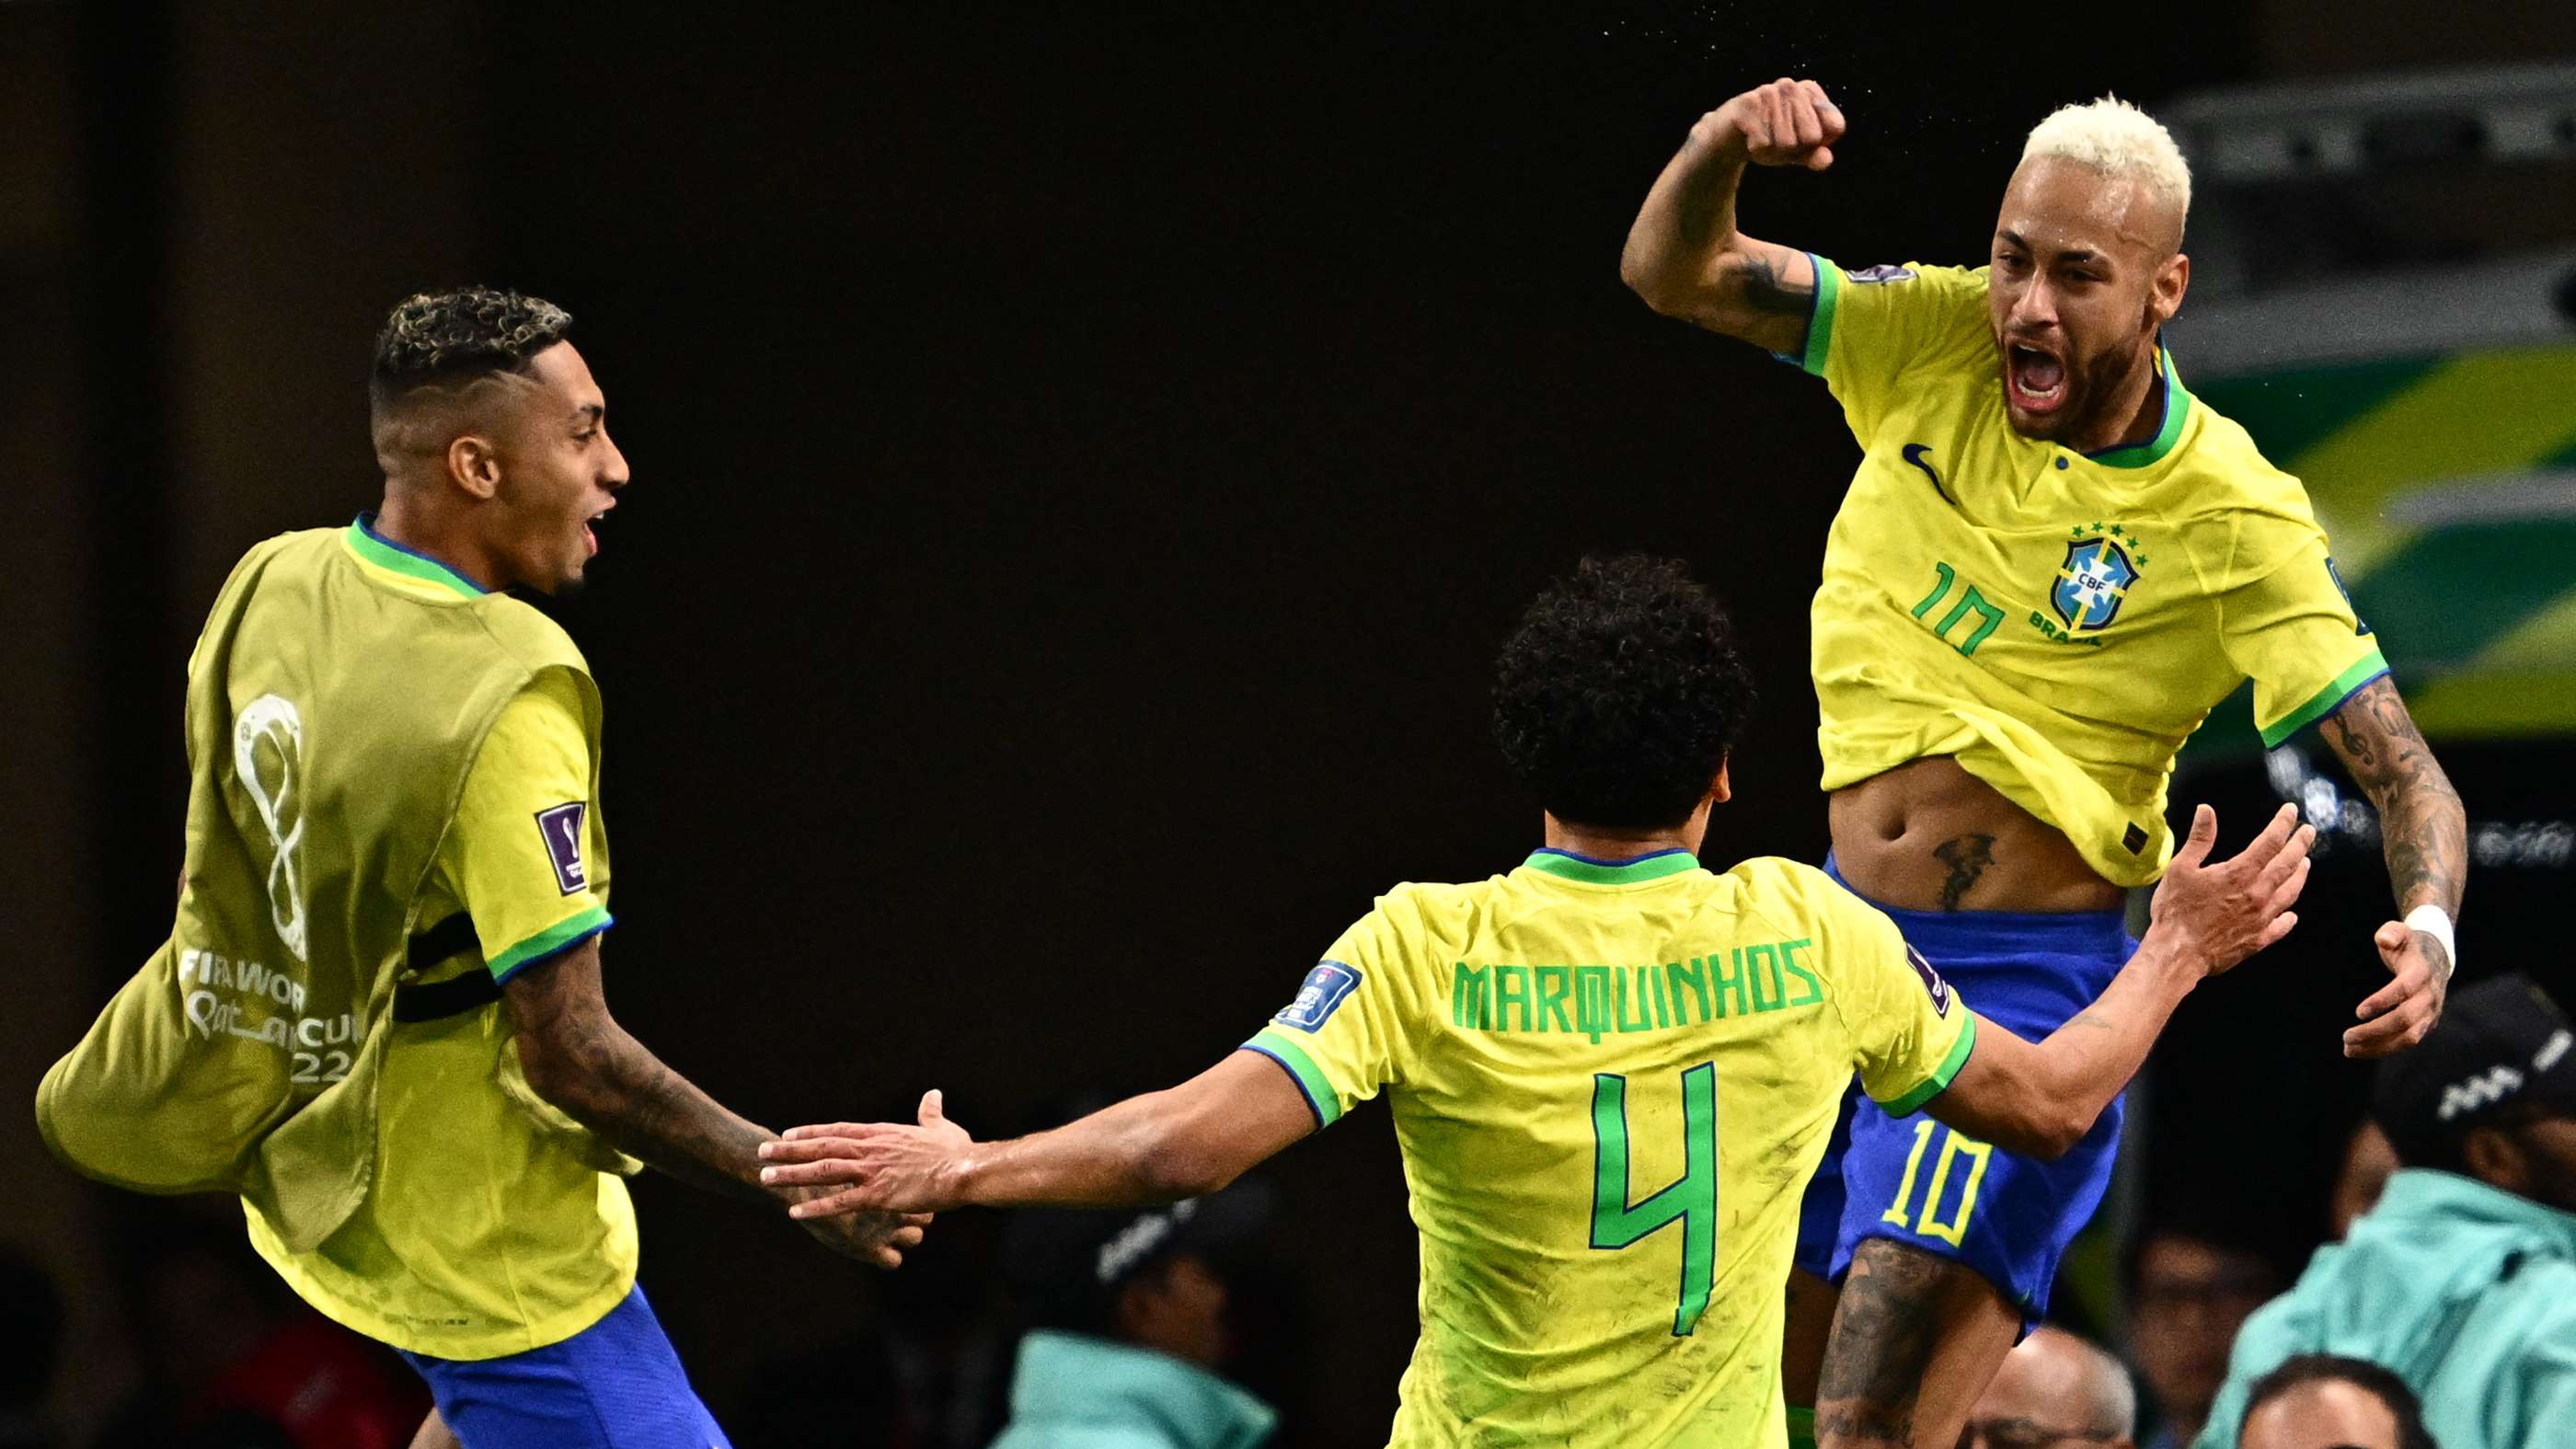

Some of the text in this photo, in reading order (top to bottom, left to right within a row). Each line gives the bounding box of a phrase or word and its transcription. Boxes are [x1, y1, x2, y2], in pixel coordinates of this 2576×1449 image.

[2077, 572, 2106, 591] CBF
[1452, 938, 1823, 1045] MARQUINHOS
[290, 1050, 350, 1083] 22
[1589, 1060, 1718, 1337] 4
[1881, 1120, 1994, 1249] 10
